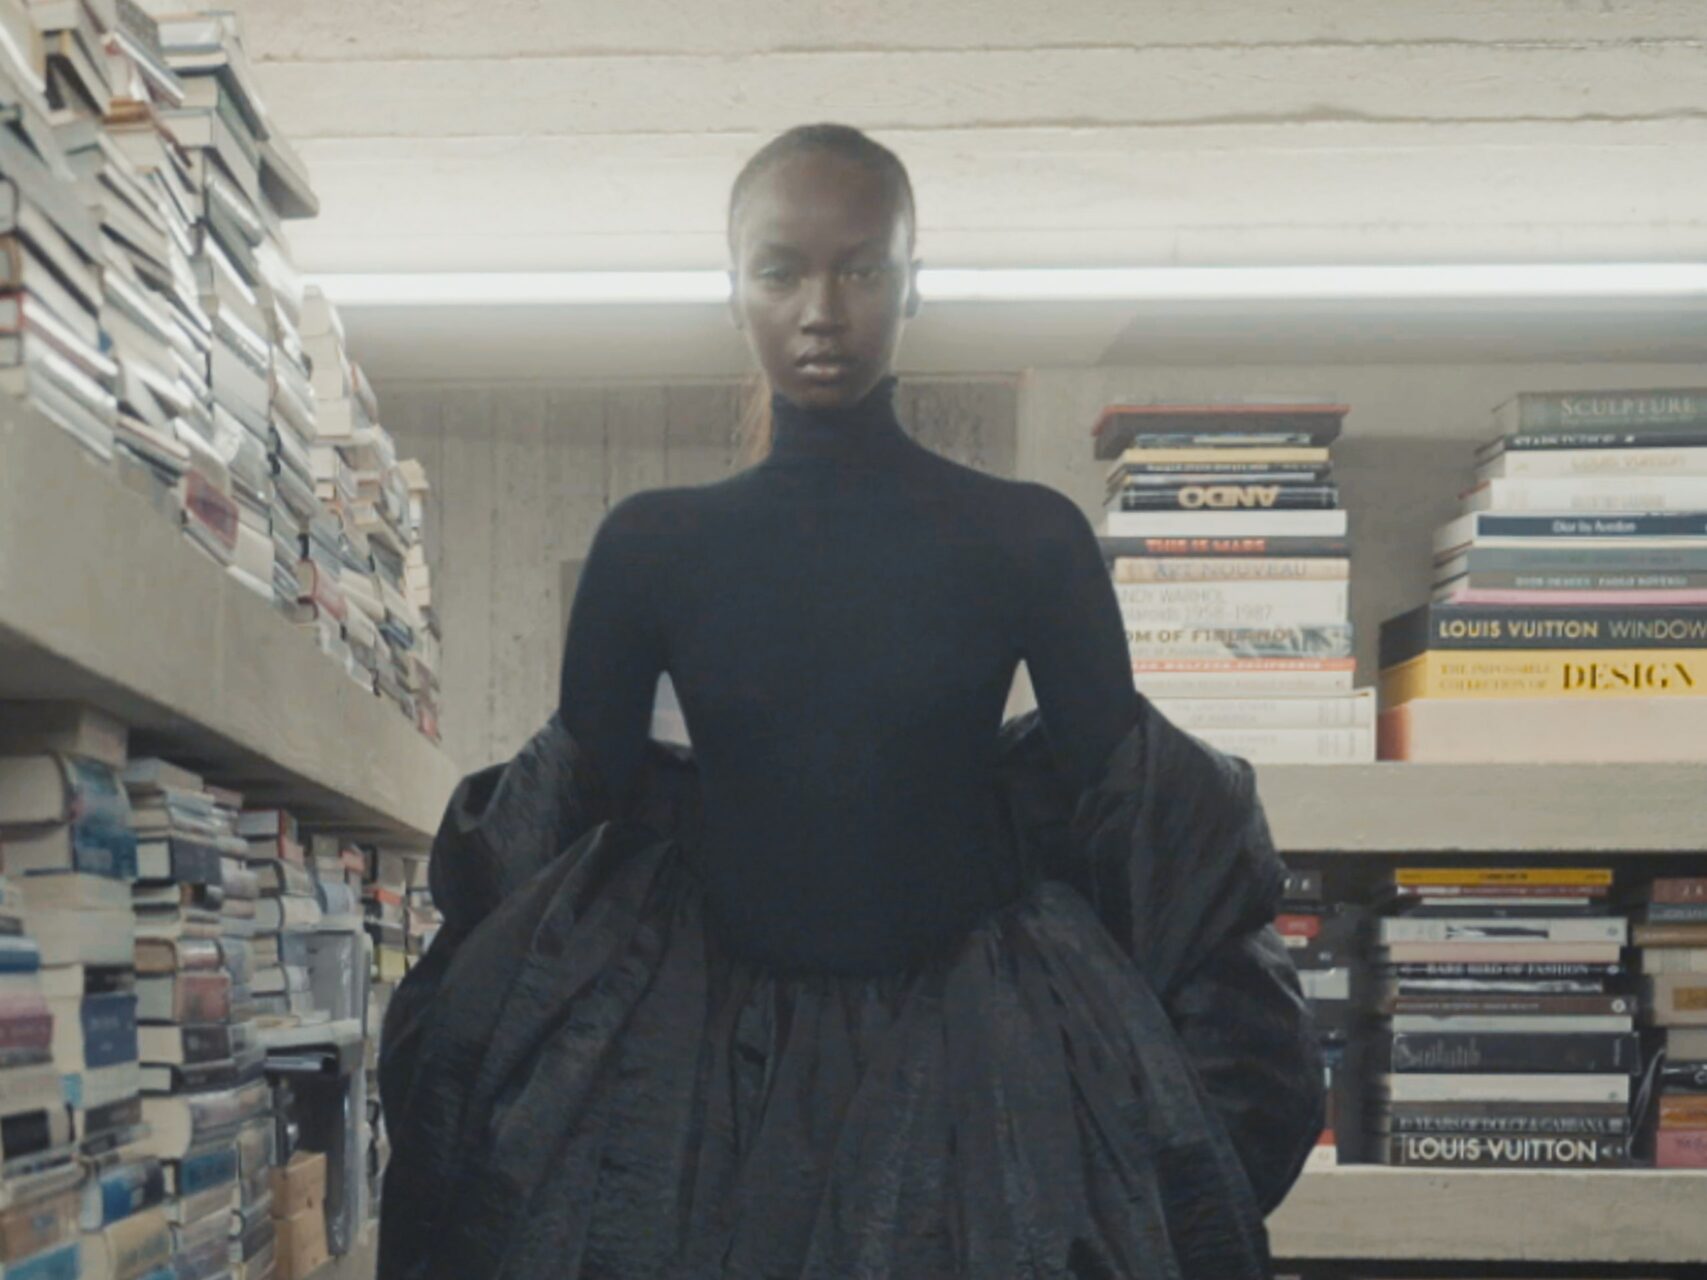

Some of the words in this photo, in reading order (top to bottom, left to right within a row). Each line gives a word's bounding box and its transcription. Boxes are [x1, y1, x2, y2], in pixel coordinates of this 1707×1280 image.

[1561, 398, 1697, 416] SCULPTURE
[1178, 485, 1281, 509] ANDO
[1201, 561, 1307, 578] NOUVEAU
[1156, 629, 1185, 644] OF
[1438, 619, 1502, 639] LOUIS
[1507, 619, 1600, 639] VUITTON
[1608, 618, 1707, 639] WINDOW
[1562, 662, 1695, 691] DESIGN
[1408, 1136, 1482, 1162] LOUIS
[1485, 1137, 1598, 1163] VUITTON
